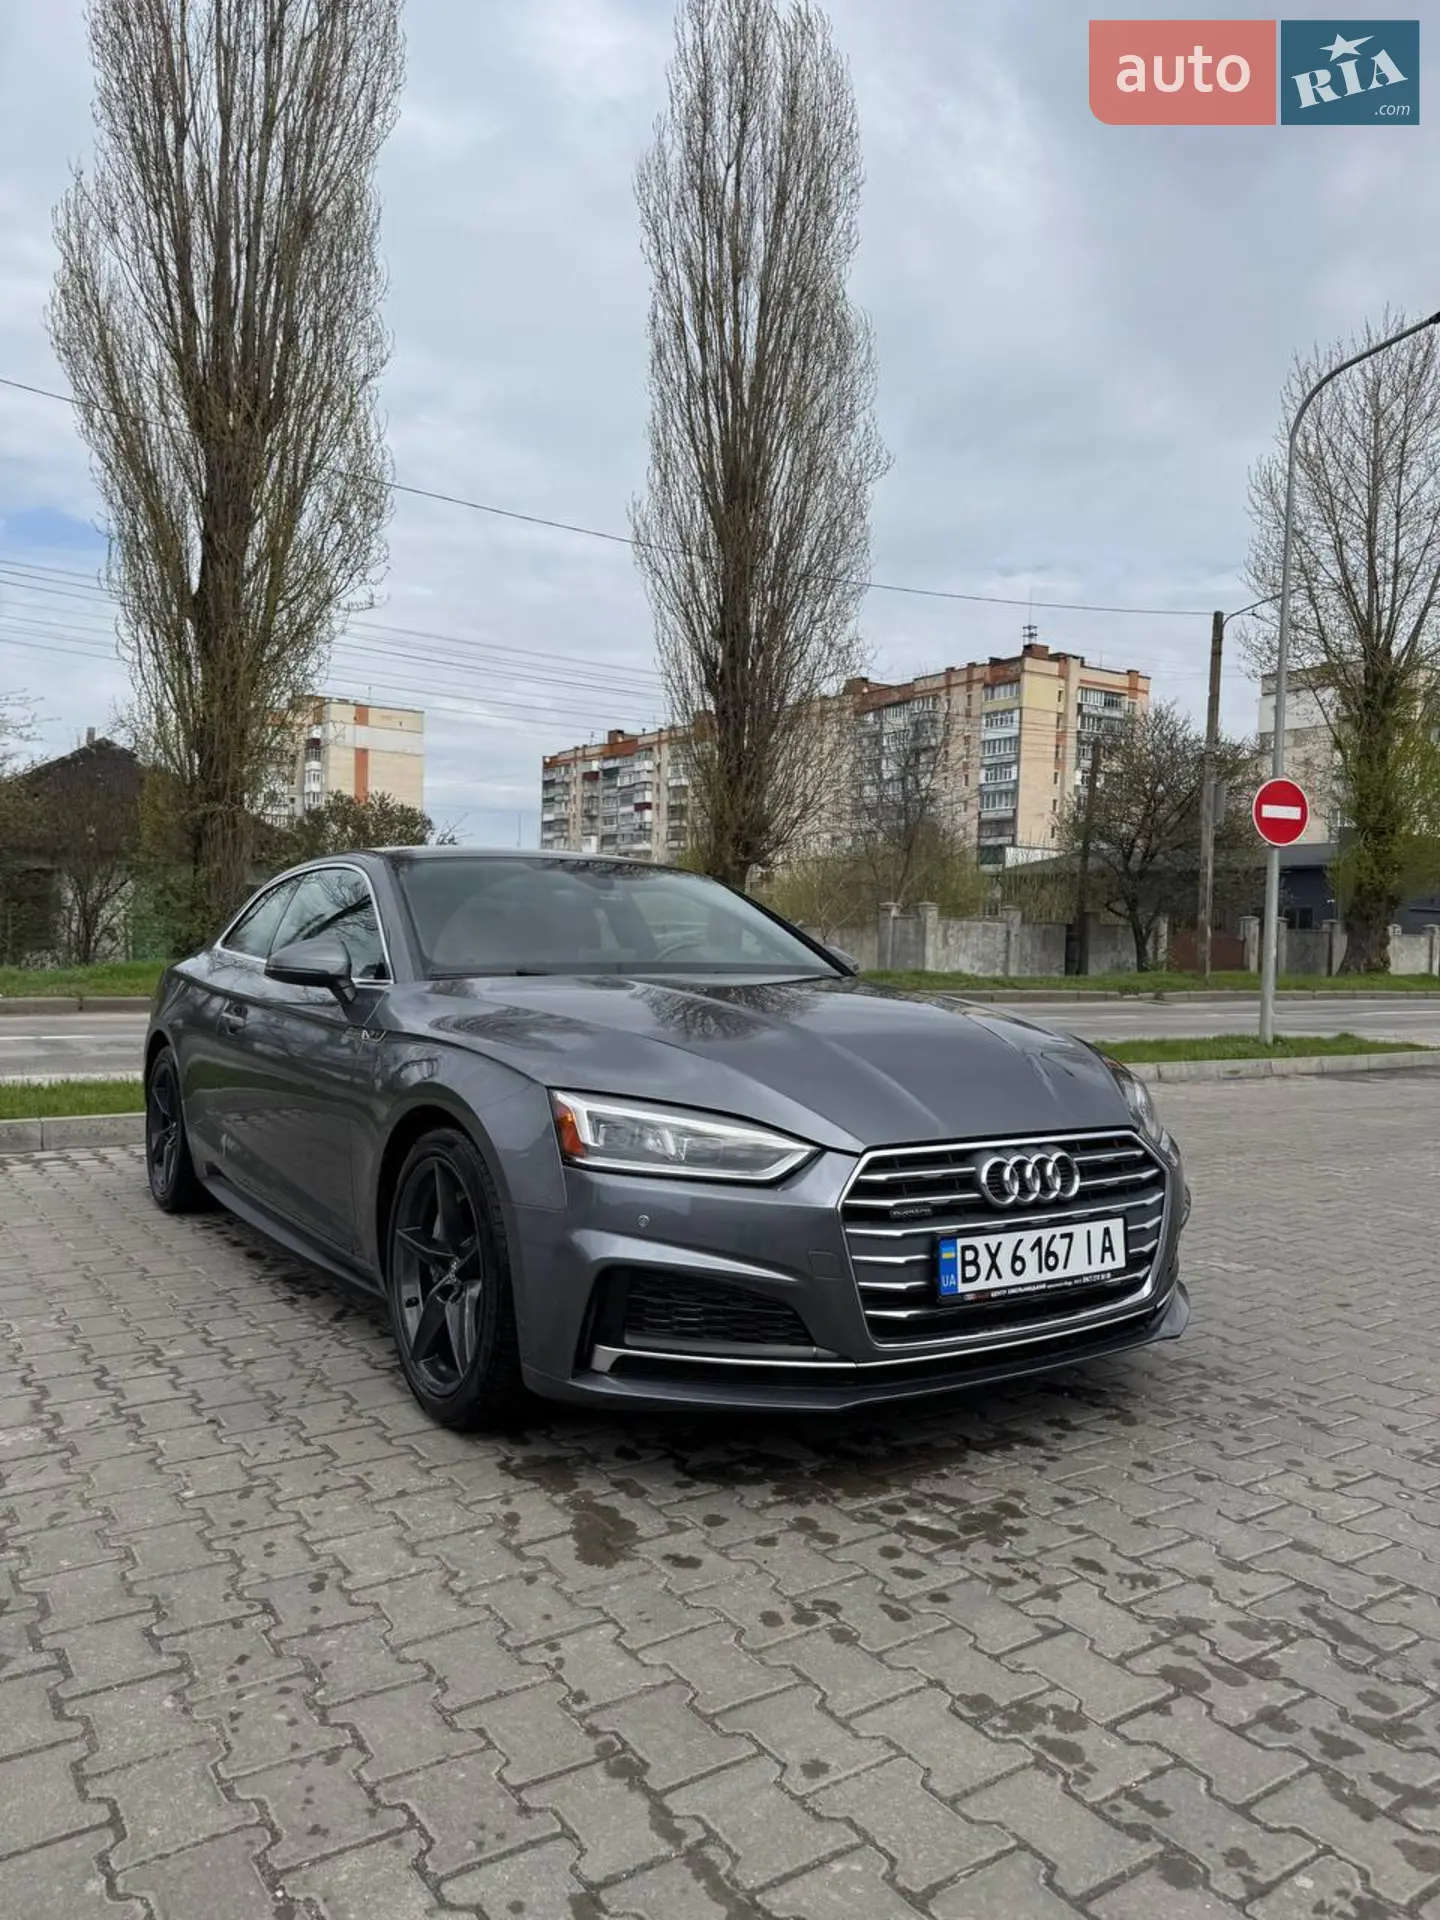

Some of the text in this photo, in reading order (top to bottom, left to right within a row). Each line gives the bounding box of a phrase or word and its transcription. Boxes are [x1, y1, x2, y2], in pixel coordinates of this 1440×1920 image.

[960, 1226, 1116, 1284] BX 6167 IA
[942, 1274, 957, 1287] UA
